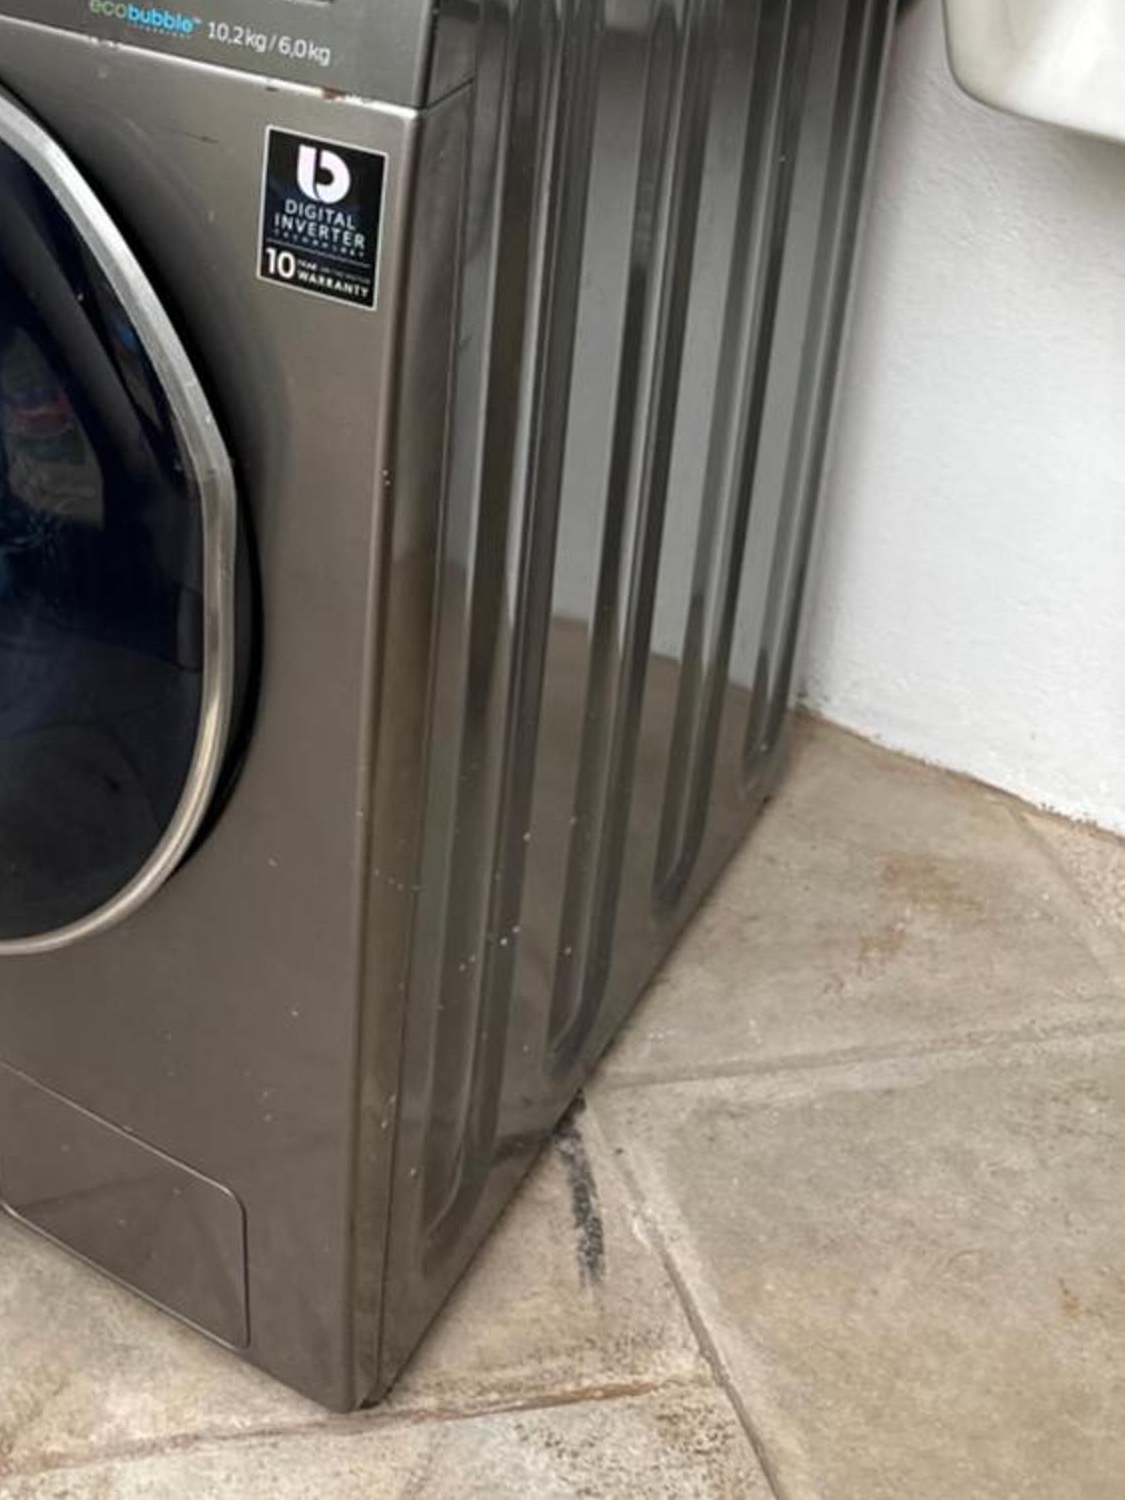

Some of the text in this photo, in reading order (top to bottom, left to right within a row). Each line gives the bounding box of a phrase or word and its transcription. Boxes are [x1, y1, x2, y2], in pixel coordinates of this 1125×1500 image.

[275, 213, 365, 248] INVERTER
[285, 199, 355, 230] DIGITAL
[266, 248, 296, 279] 10
[297, 270, 369, 298] WARRANTY
